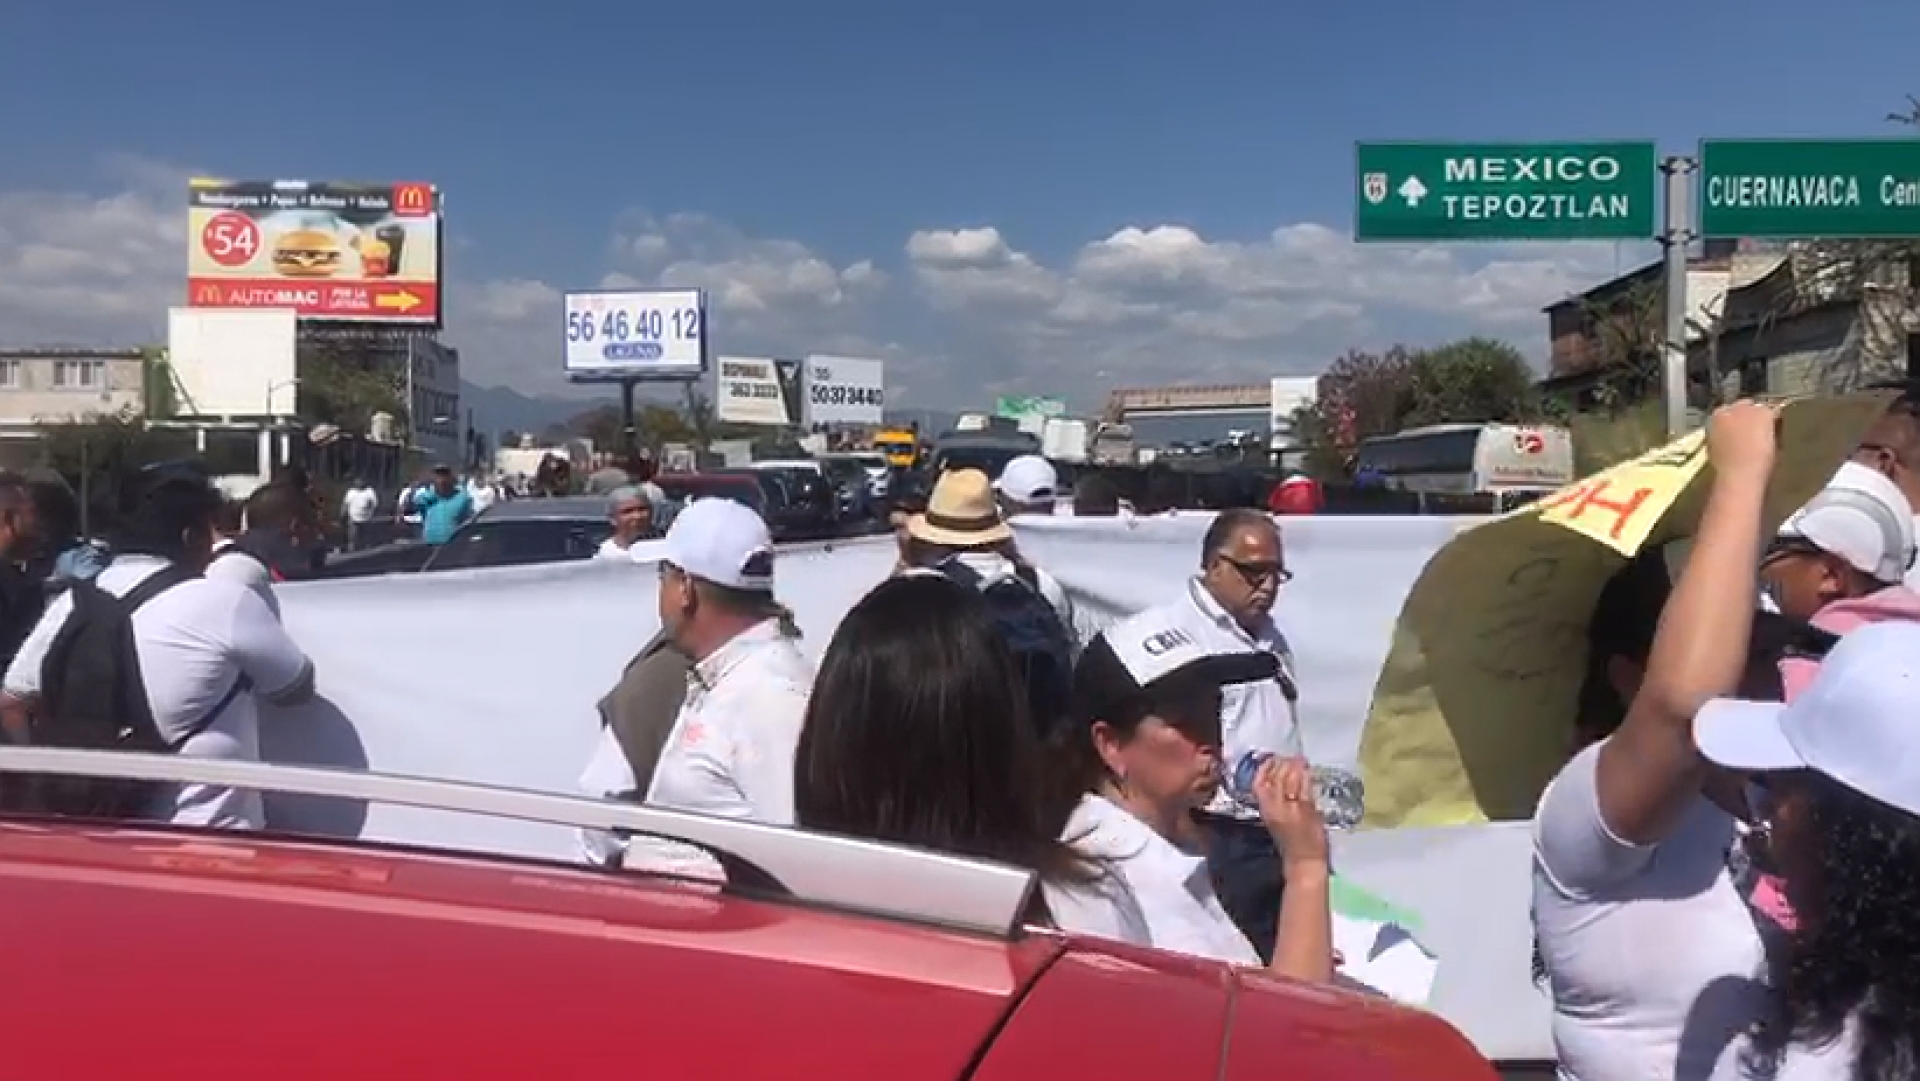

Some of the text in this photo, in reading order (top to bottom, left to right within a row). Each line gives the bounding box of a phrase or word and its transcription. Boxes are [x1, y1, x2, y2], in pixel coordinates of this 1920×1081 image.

[1445, 157, 1621, 181] MEXICO
[1708, 174, 1920, 207] CUERNAVACA Cen
[1442, 195, 1629, 218] TEPOZTLAN
[568, 308, 697, 341] 56 46 40 12
